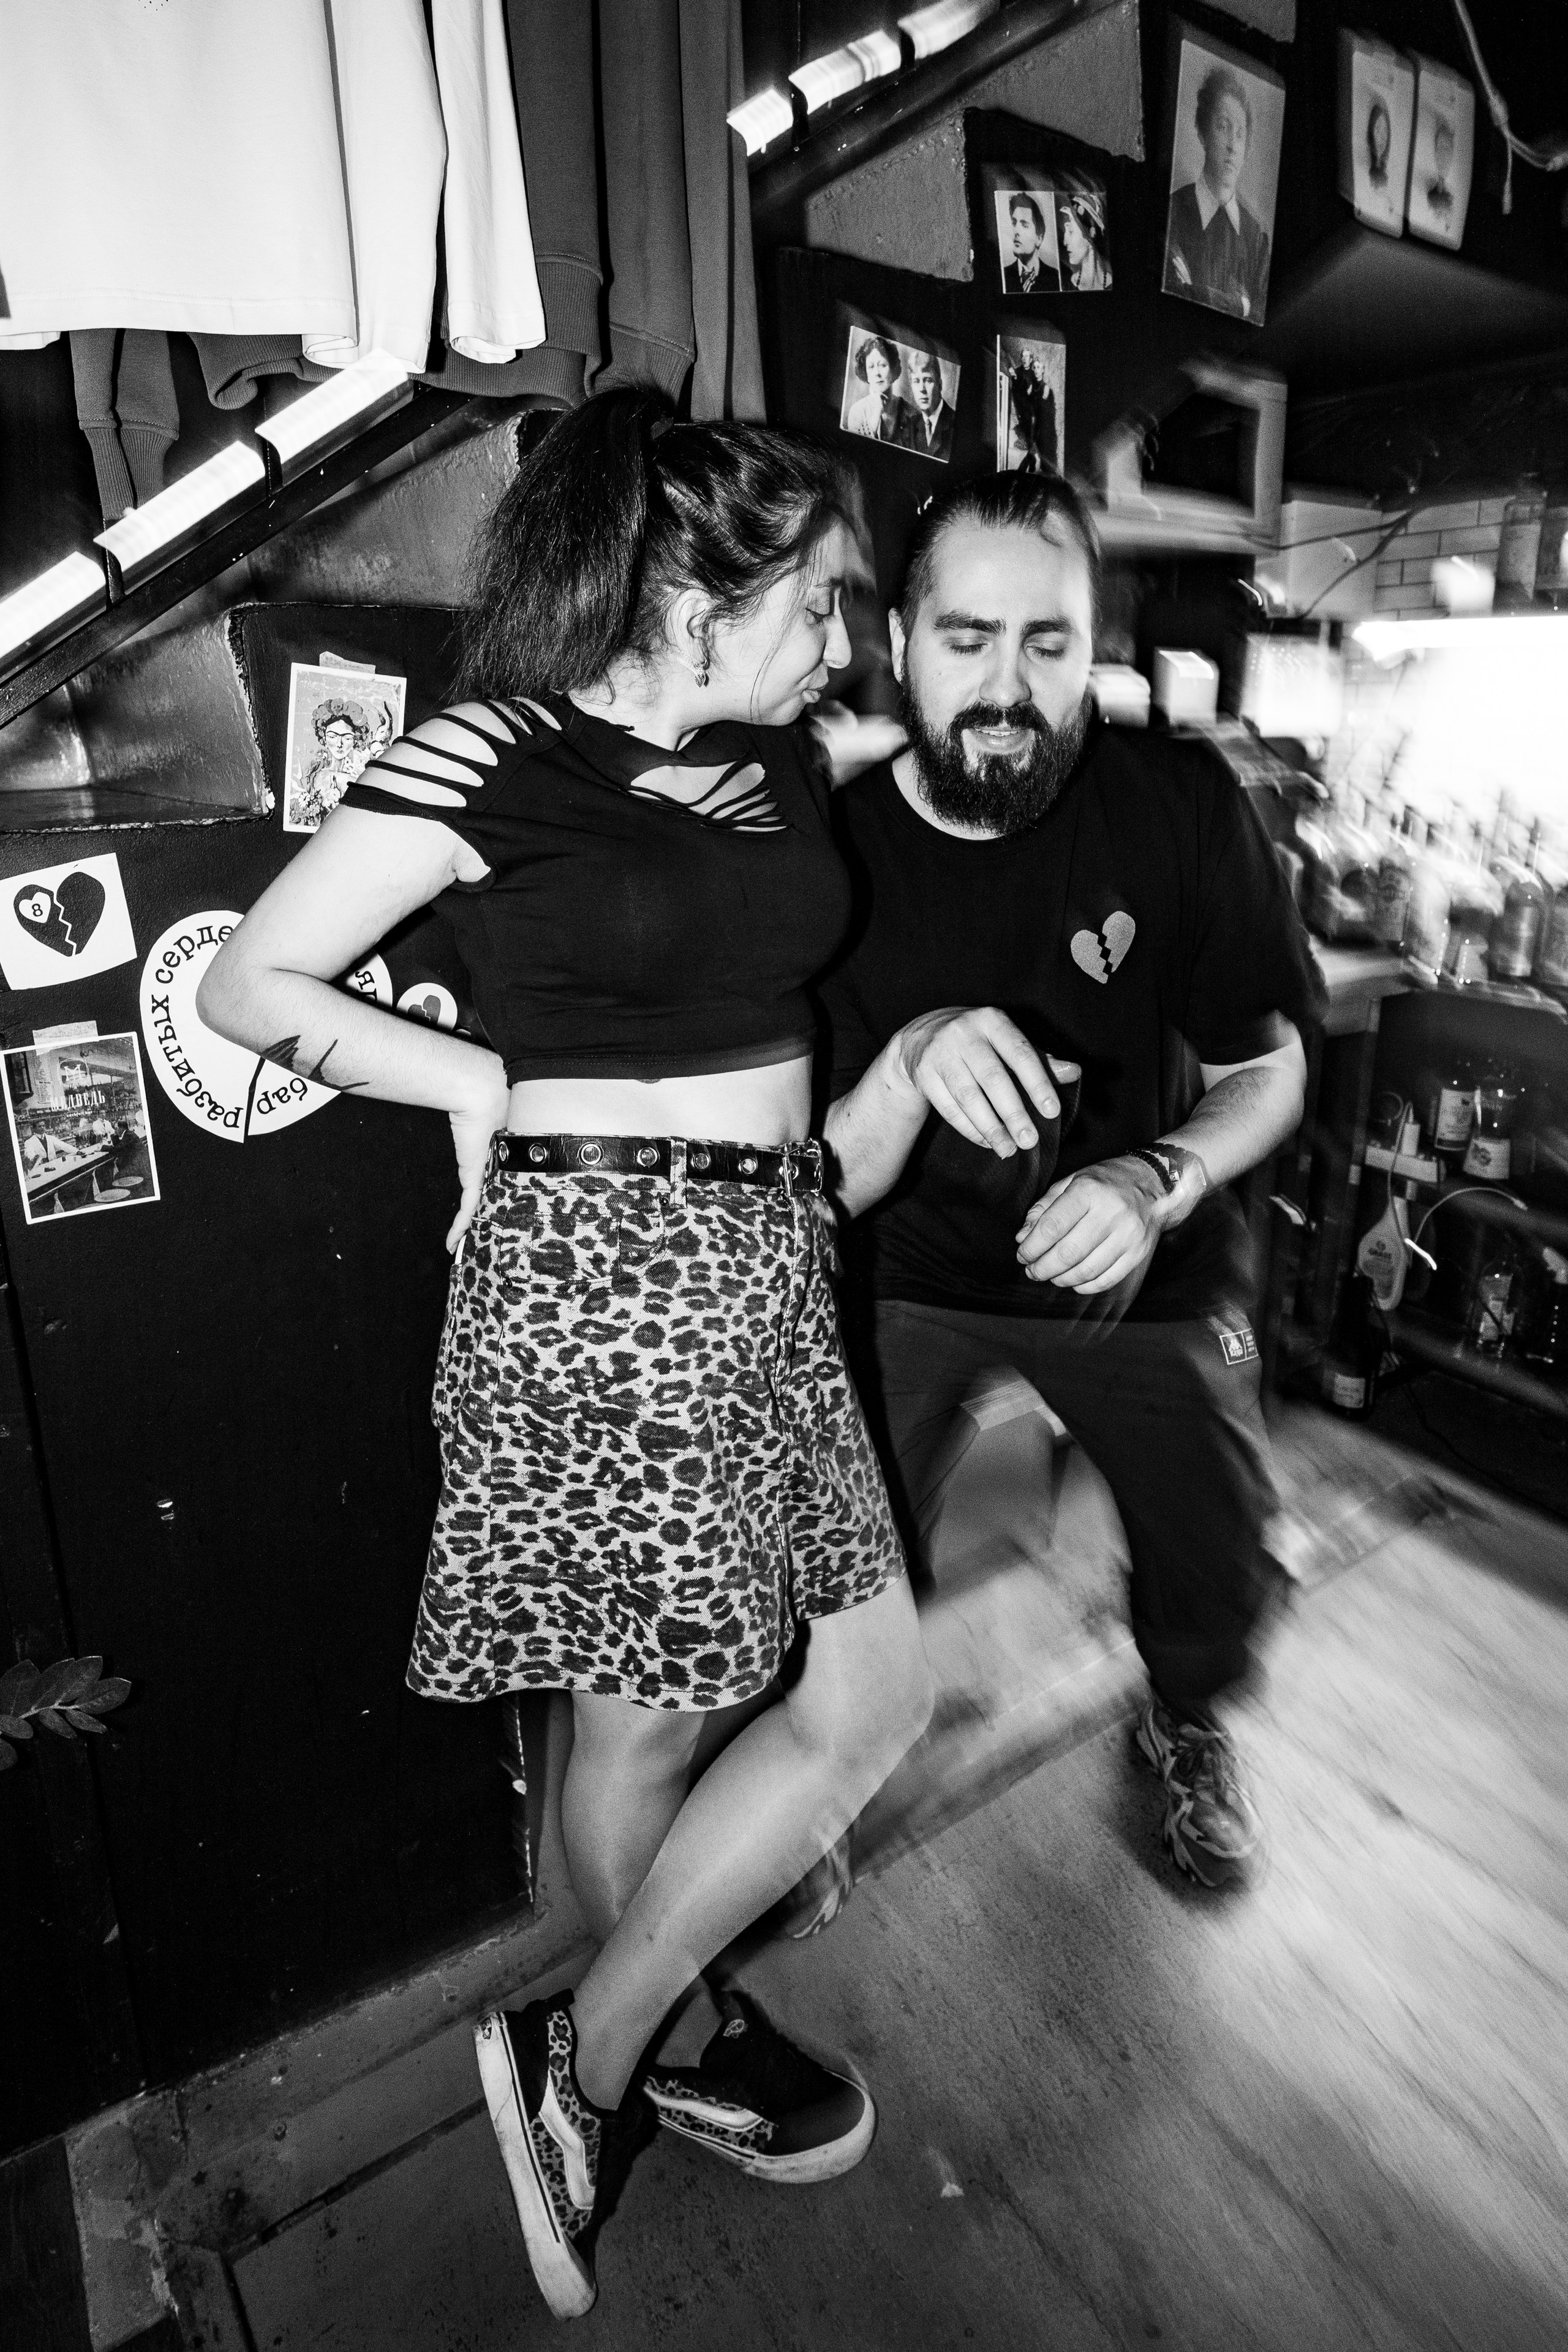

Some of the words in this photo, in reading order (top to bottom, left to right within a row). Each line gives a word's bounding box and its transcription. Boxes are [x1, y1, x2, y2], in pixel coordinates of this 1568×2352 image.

[31, 903, 43, 917] 8
[155, 925, 235, 984] серде
[151, 994, 244, 1128] разбитых
[257, 1077, 308, 1115] бар
